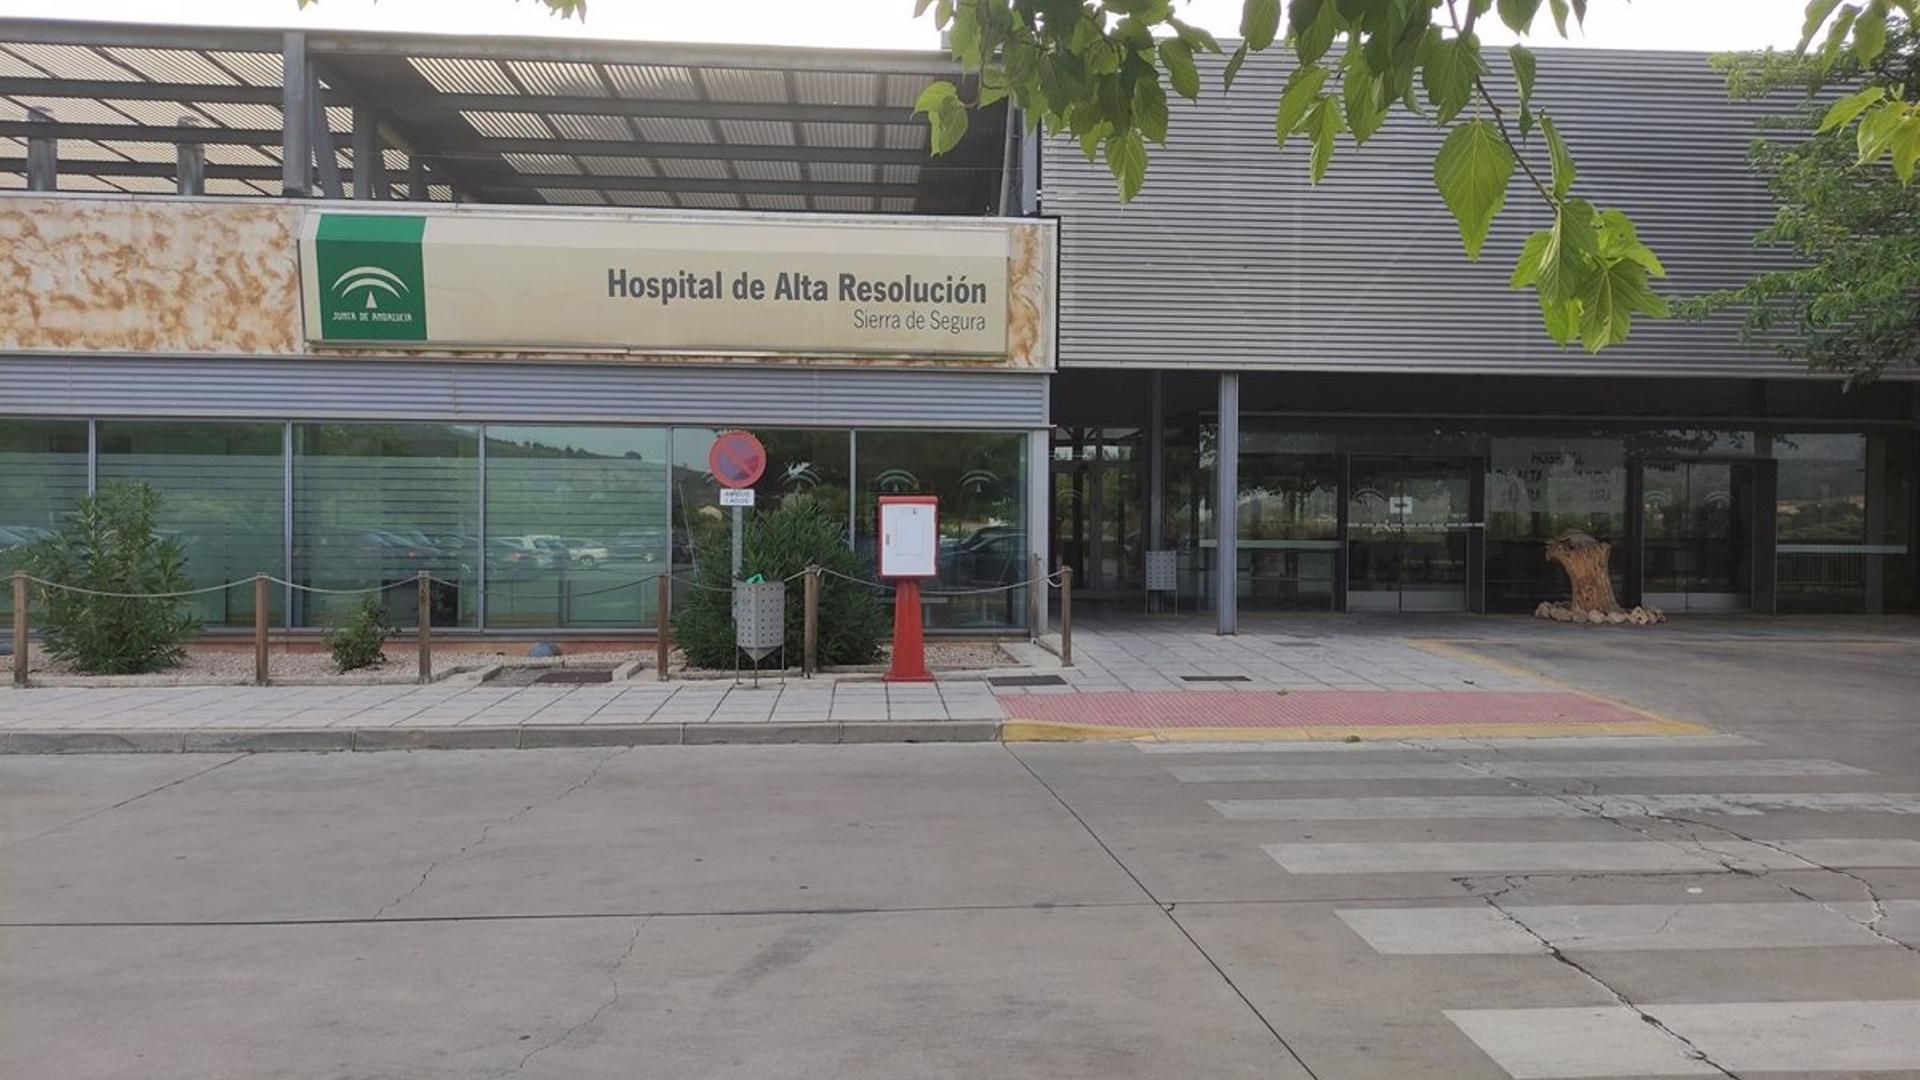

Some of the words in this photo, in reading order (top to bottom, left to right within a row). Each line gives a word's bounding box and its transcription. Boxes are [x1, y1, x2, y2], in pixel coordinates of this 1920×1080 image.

[608, 268, 724, 306] Hospital
[731, 271, 766, 302] de
[773, 272, 829, 303] Alta
[838, 273, 987, 305] Resolución
[332, 311, 357, 321] JUNTA
[359, 312, 369, 322] DE
[853, 309, 901, 330] Sierra
[905, 310, 926, 331] de
[930, 310, 986, 334] Segura
